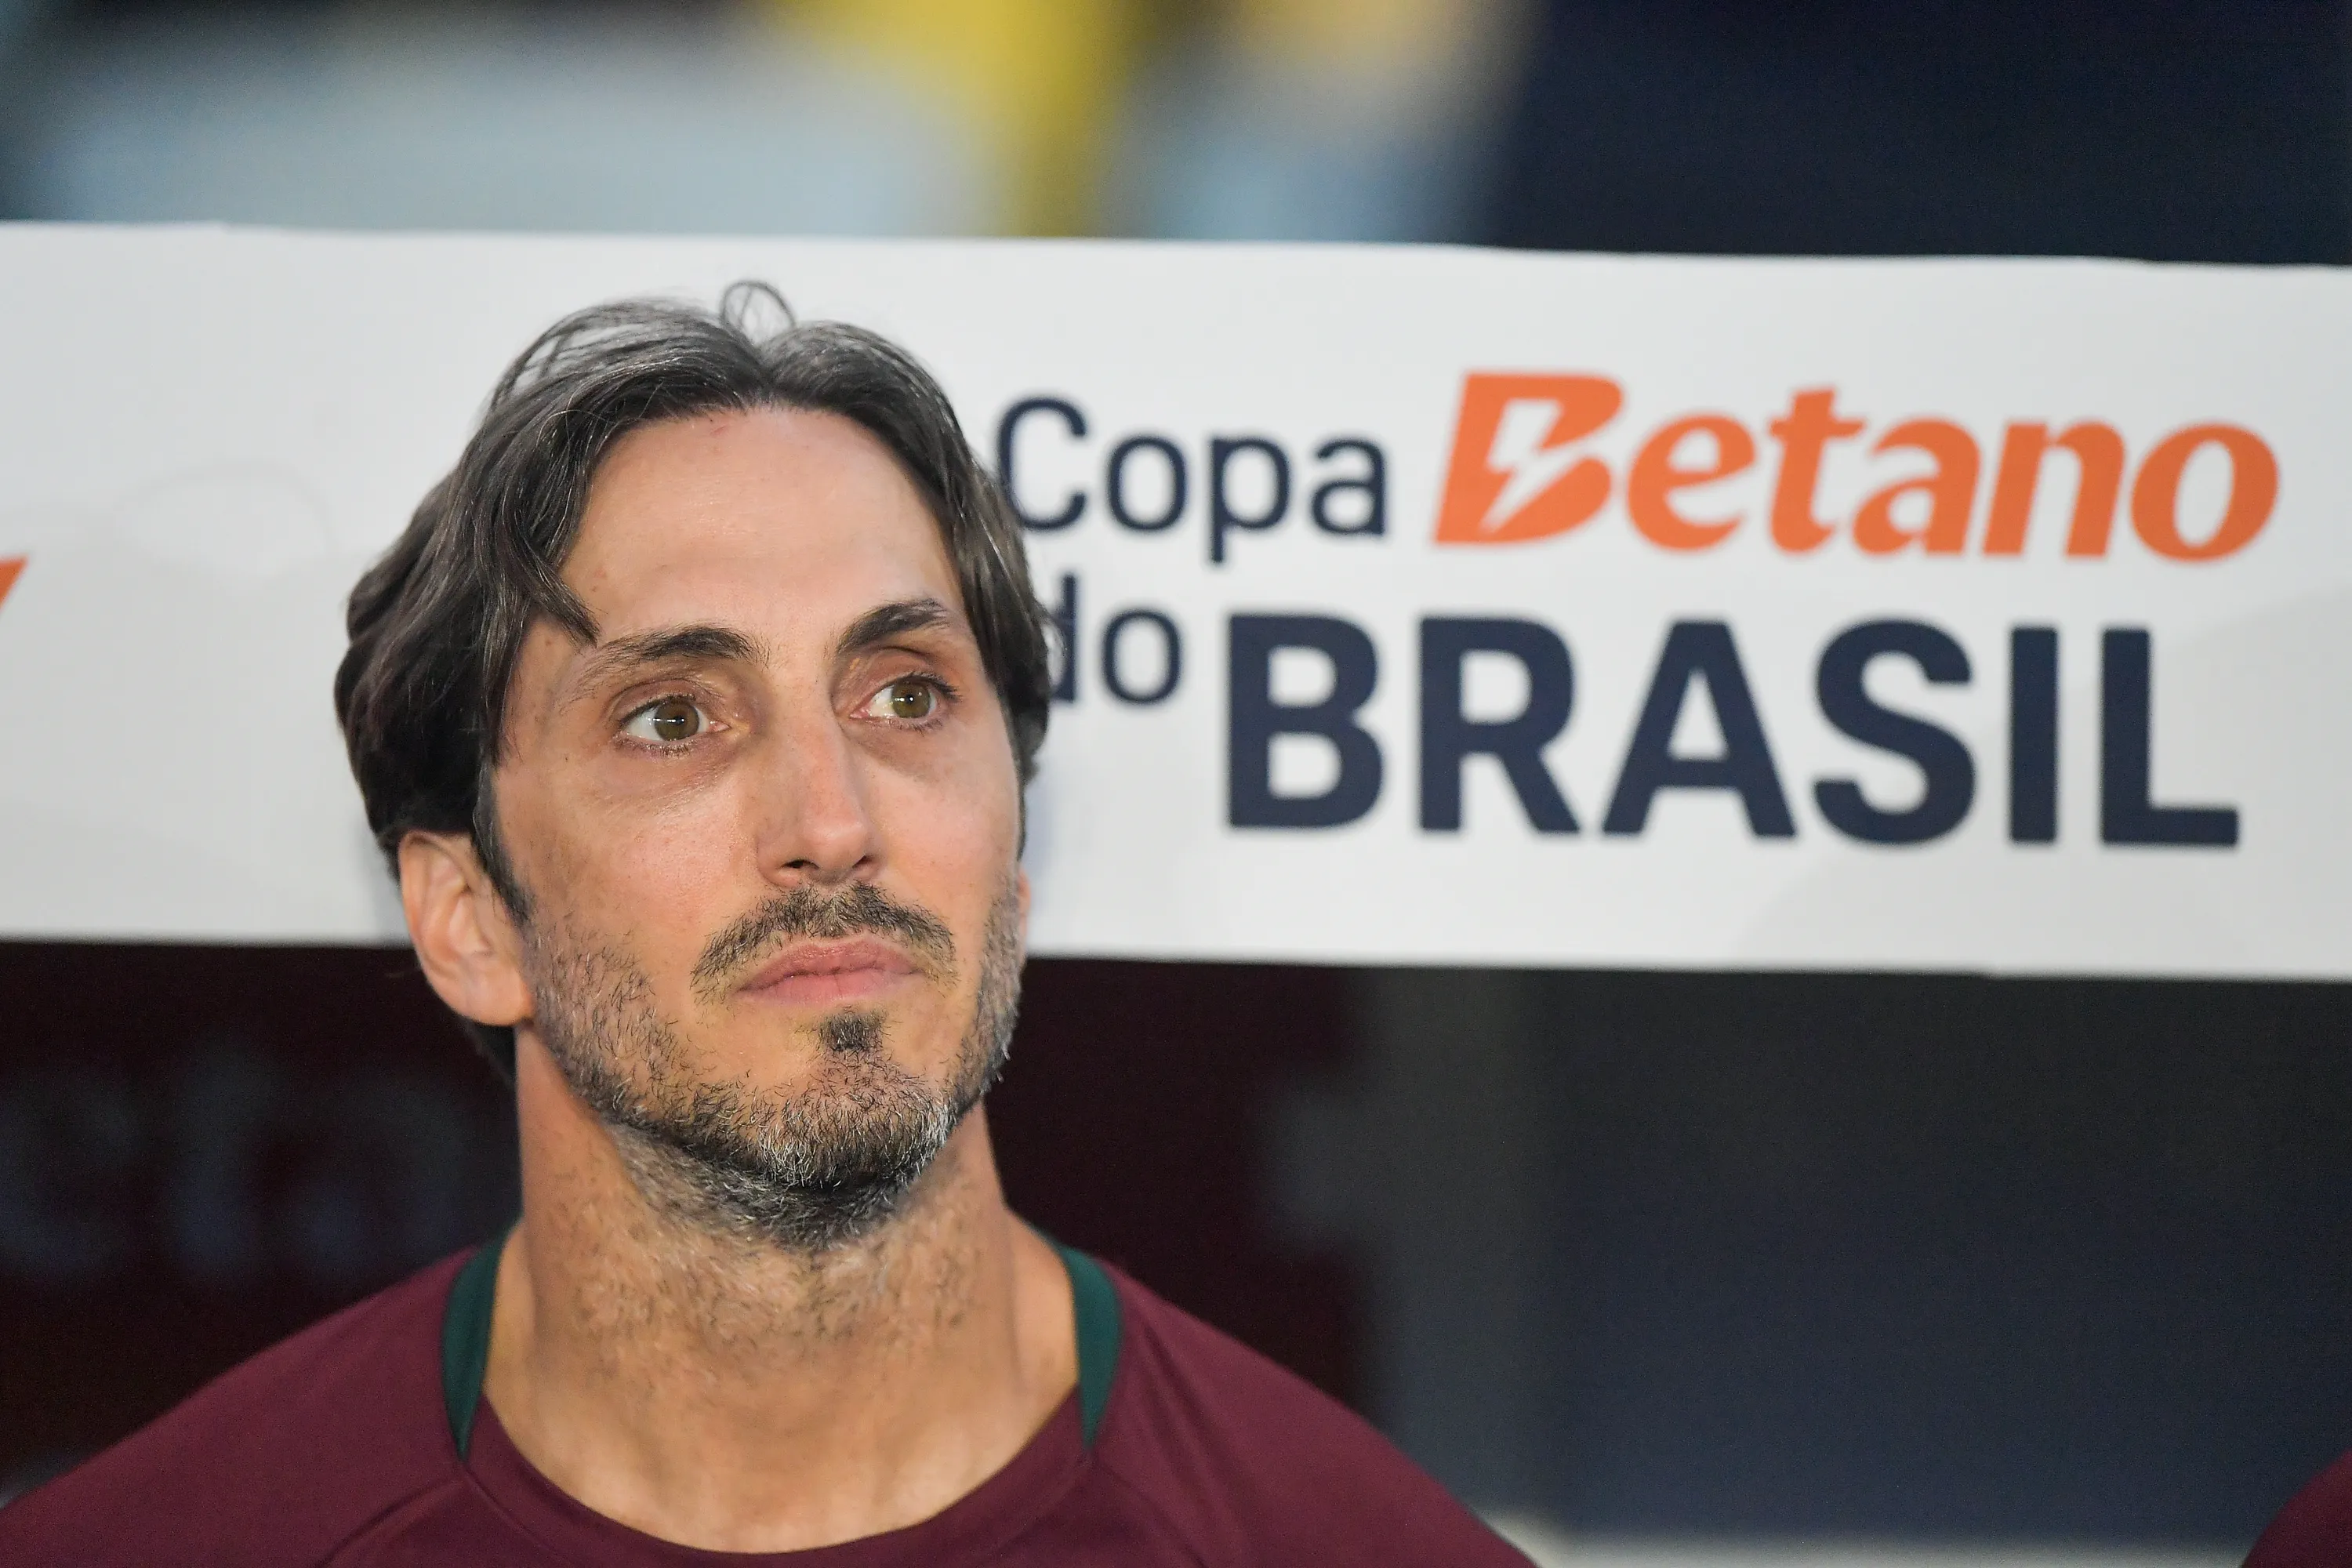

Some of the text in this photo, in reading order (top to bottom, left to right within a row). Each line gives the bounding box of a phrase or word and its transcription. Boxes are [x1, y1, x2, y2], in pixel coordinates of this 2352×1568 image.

[996, 371, 2280, 564] Copa Betano
[1226, 612, 2240, 847] BRASIL
